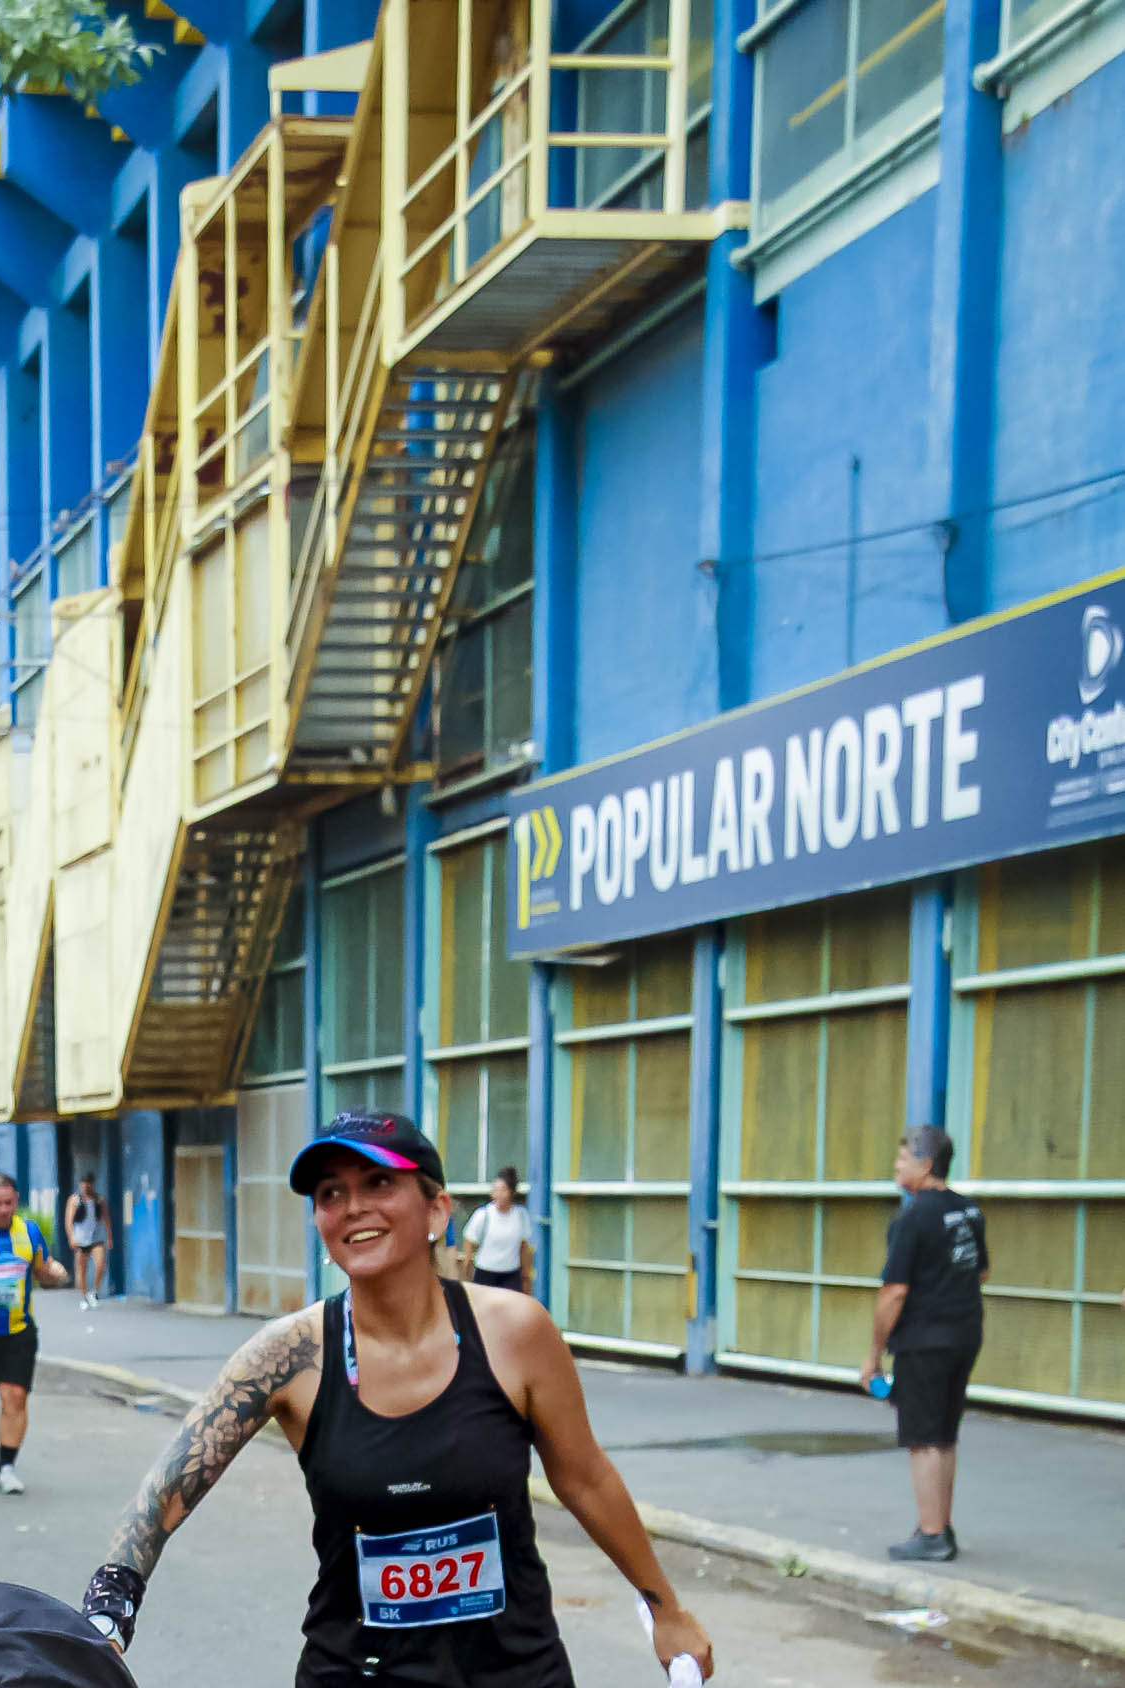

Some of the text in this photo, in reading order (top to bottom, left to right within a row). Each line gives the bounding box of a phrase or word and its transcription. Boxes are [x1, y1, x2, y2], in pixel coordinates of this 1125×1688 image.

[569, 746, 775, 911] POPULAR
[784, 675, 985, 860] NORTE
[425, 1533, 458, 1551] RUS
[380, 1551, 485, 1600] 6827
